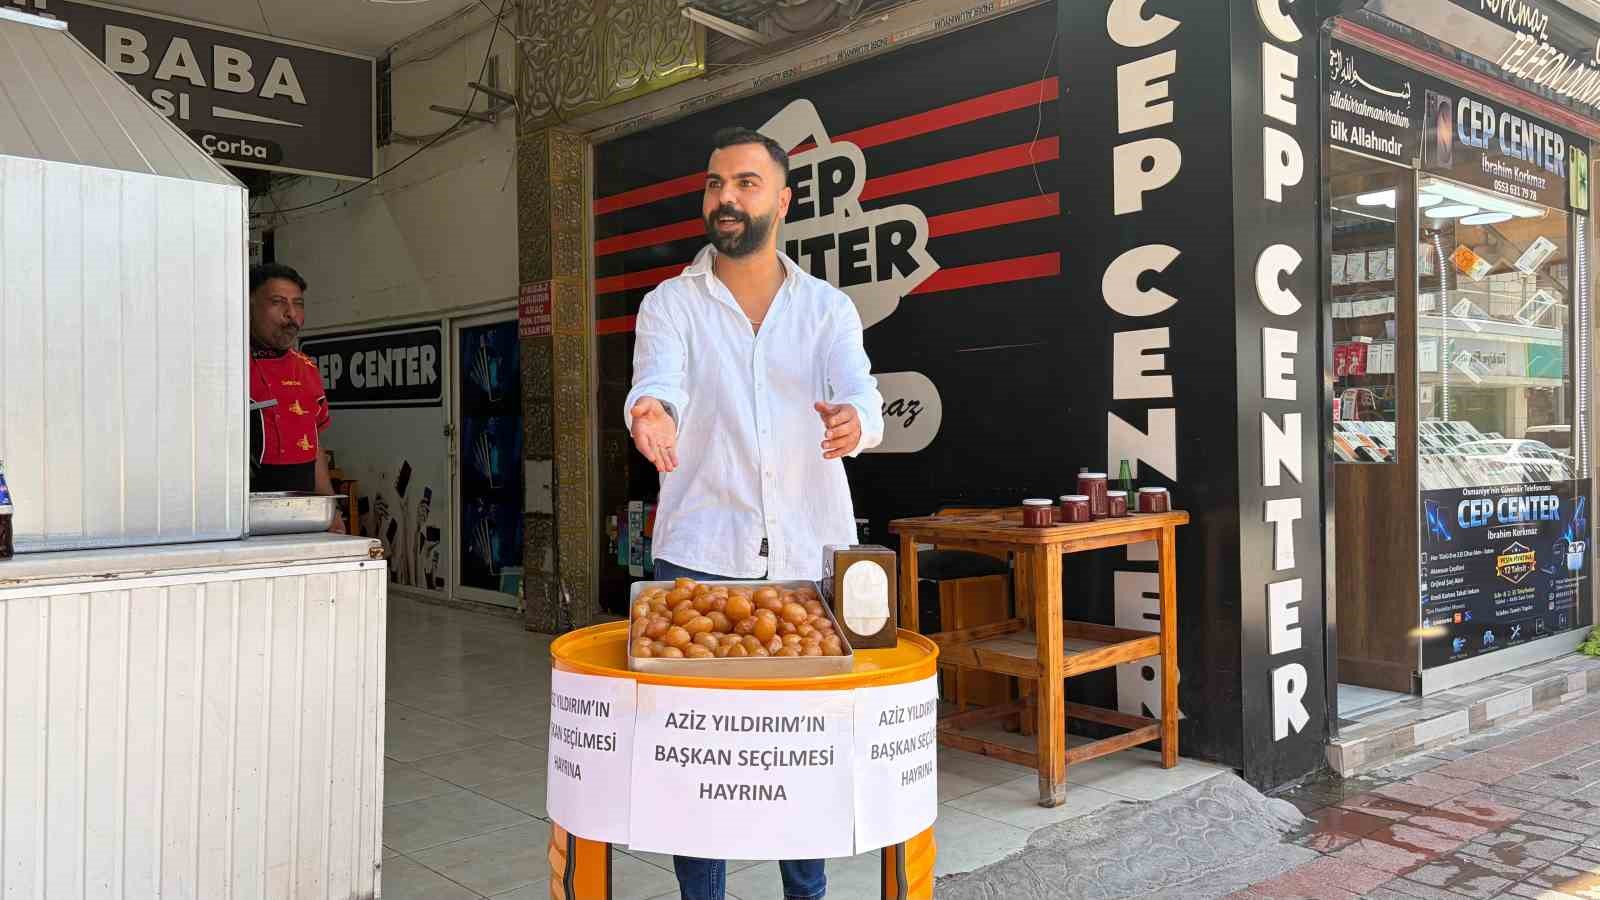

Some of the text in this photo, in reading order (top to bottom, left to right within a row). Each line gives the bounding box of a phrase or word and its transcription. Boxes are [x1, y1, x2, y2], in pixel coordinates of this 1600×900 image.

[105, 24, 307, 105] BABA
[1496, 31, 1576, 89] TELEFON
[201, 134, 268, 159] Çorba
[1330, 120, 1403, 156] ülk Allahındır
[1457, 96, 1565, 178] CEP CENTER
[1482, 152, 1546, 189] İbrahim Korkmaz
[785, 155, 856, 225] EP
[313, 344, 439, 390] EP CENTER
[1255, 243, 1310, 743] CENTER
[1457, 495, 1560, 529] CEP CENTER
[665, 709, 826, 733] AZİZ YILDIRIM'IN
[878, 705, 906, 728] AZİZ
[563, 726, 617, 752] SEÇİLMESİ
[871, 736, 917, 761] BAŞKAN
[655, 744, 835, 771] BAŞKAN SEÇİLMESİ
[699, 782, 788, 802] HAYRINA
